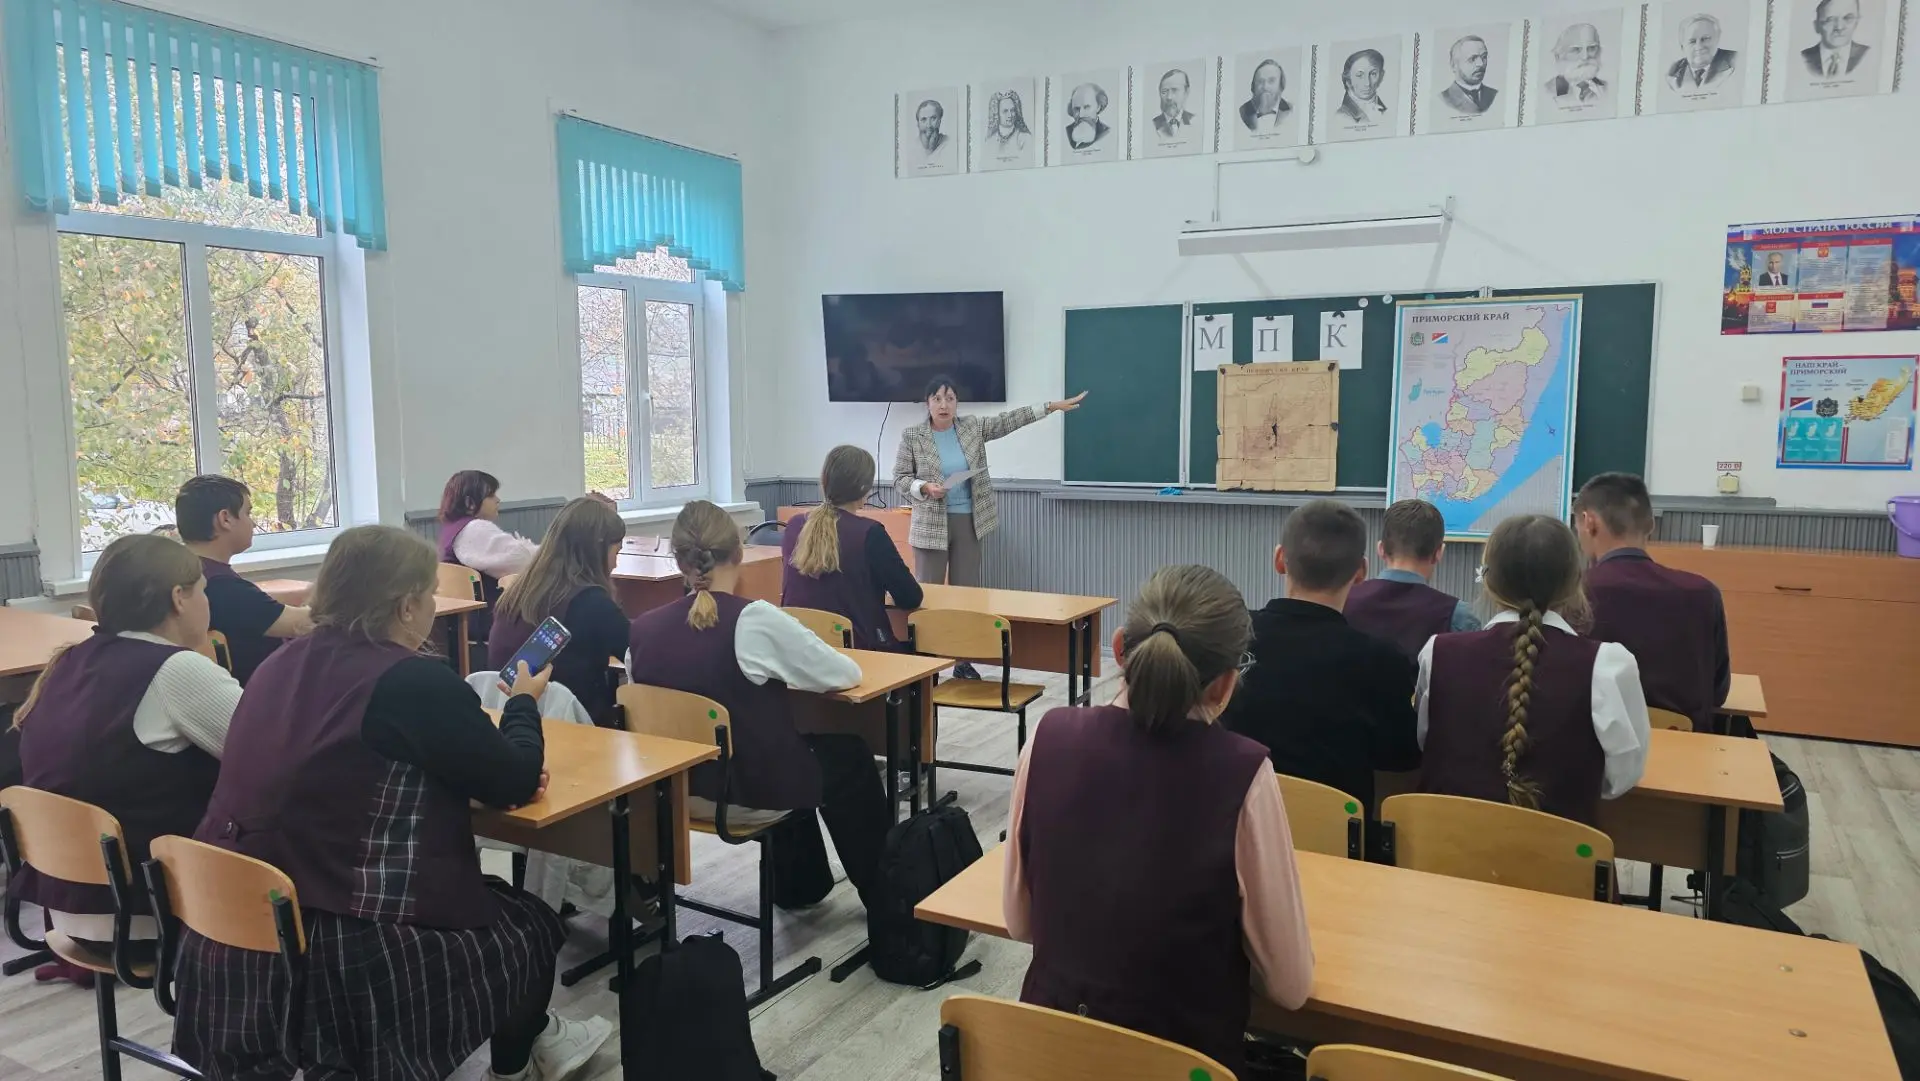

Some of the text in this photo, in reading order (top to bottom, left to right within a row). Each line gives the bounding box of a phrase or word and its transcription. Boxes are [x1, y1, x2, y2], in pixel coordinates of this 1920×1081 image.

[1763, 221, 1893, 236] МОЯ СТРАНА РОССИЯ
[1412, 311, 1510, 323] ПРИМОРСКИЙ КРАЙ
[1199, 325, 1225, 350] М
[1257, 327, 1280, 352] П
[1325, 323, 1347, 348] К
[1790, 367, 1847, 375] ПРИМОРСКИЙ
[1815, 360, 1839, 369] КРАЙ
